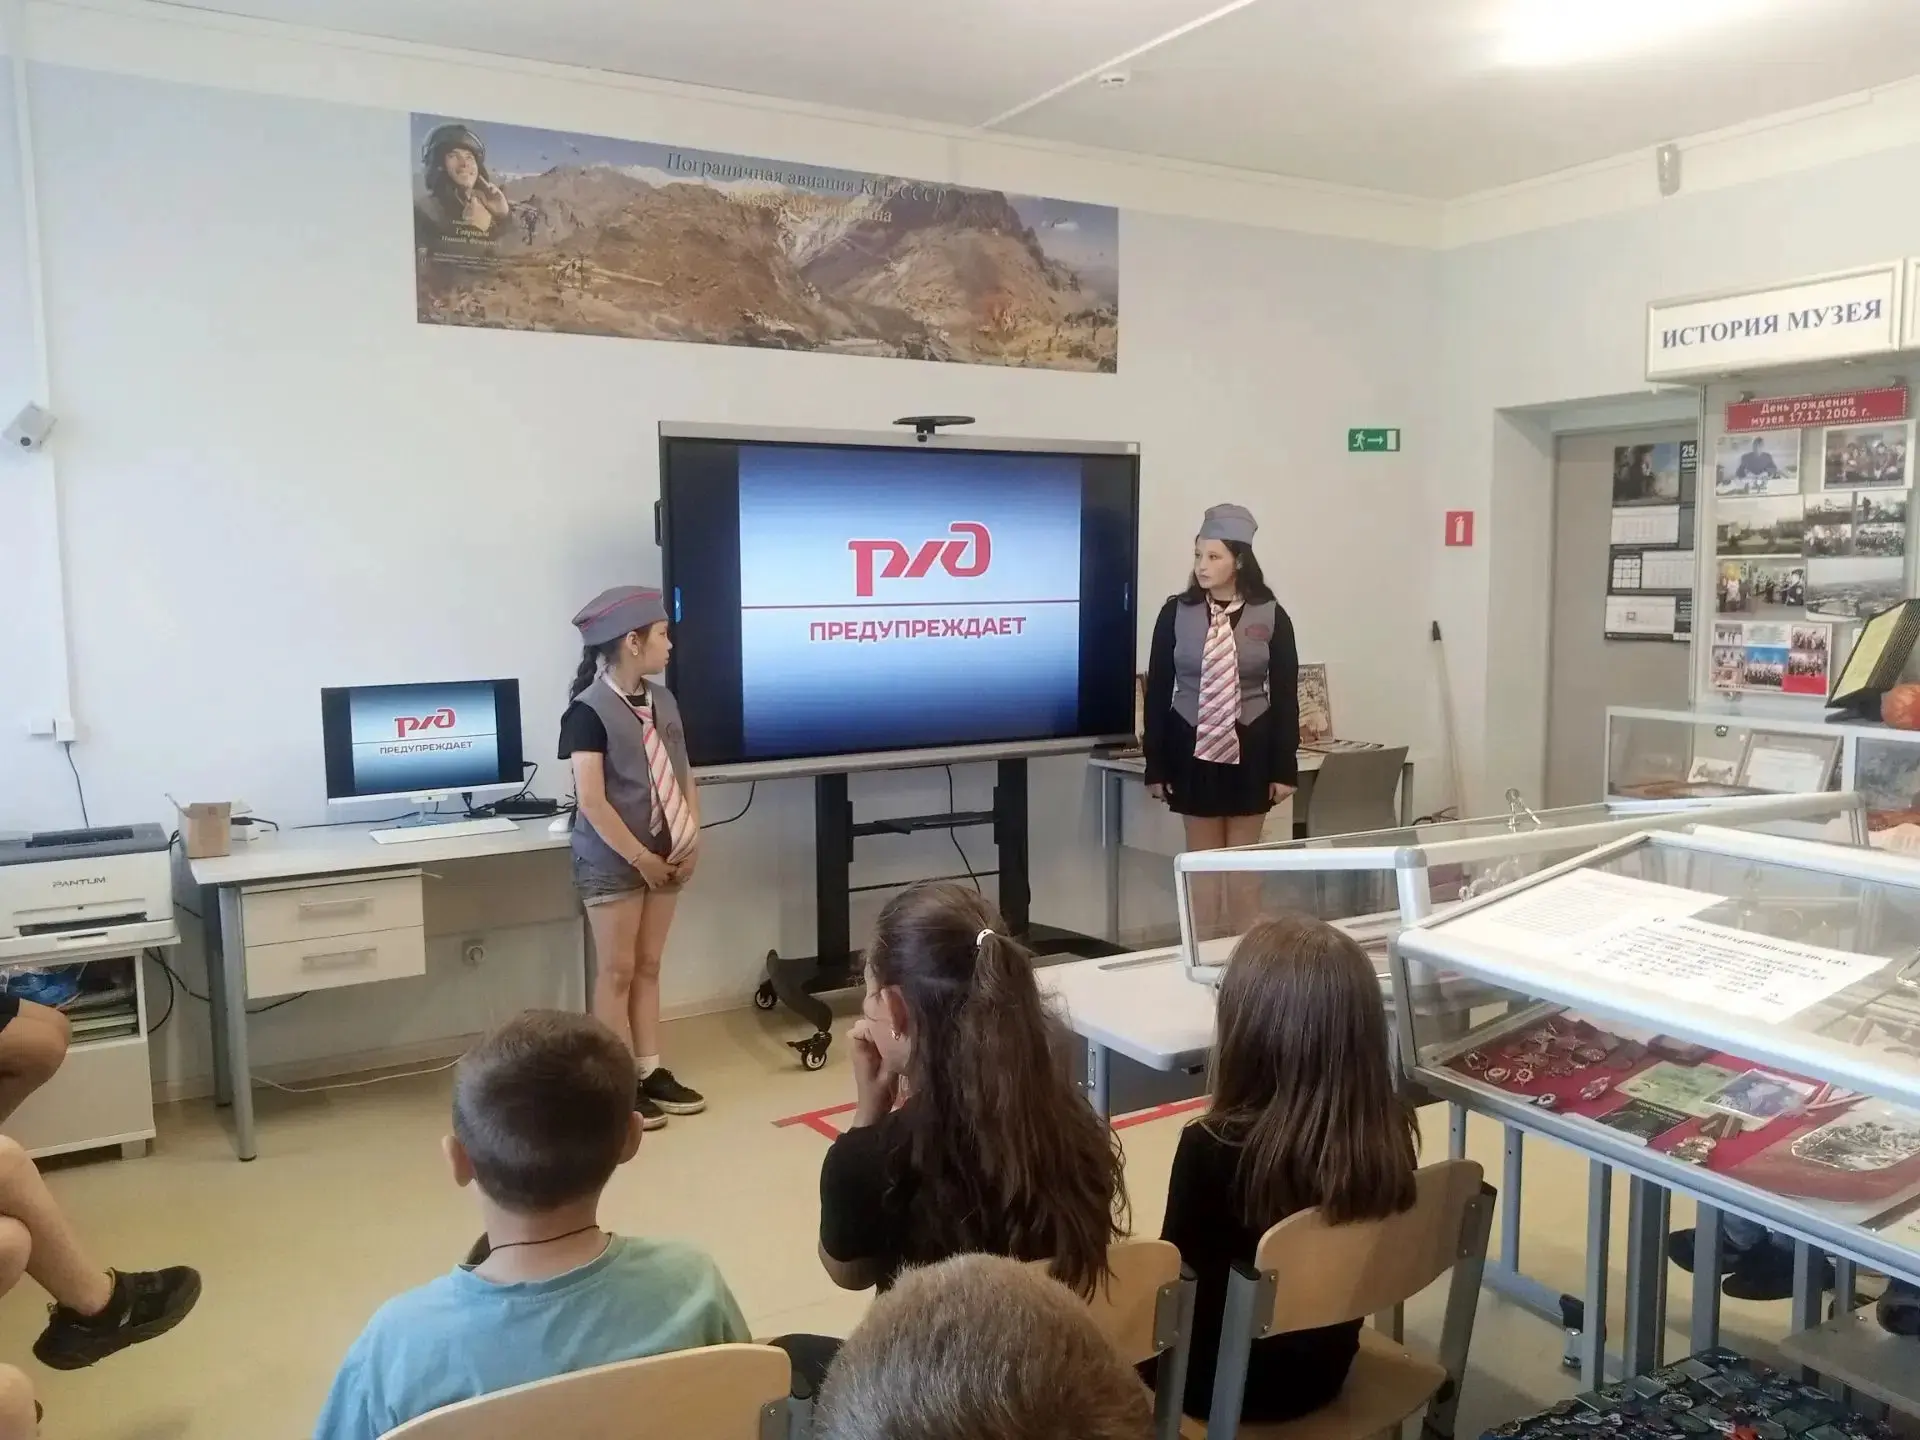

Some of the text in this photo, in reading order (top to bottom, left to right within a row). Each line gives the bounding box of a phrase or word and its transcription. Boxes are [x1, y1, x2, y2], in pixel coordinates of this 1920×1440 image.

[667, 152, 946, 205] Пограничная авиация КГБ СССР
[1662, 299, 1882, 349] ИСТОРИЯ МУЗЕЯ
[1760, 397, 1855, 415] День рождения
[1751, 415, 1785, 427] музея
[1789, 407, 1857, 423] 17.12.2006
[810, 617, 1027, 643] ПРЕДУПРЕЖДАЕТ
[380, 741, 473, 755] ПРЕДУПРЕЖДАЕТ
[52, 876, 107, 888] PANTUM
